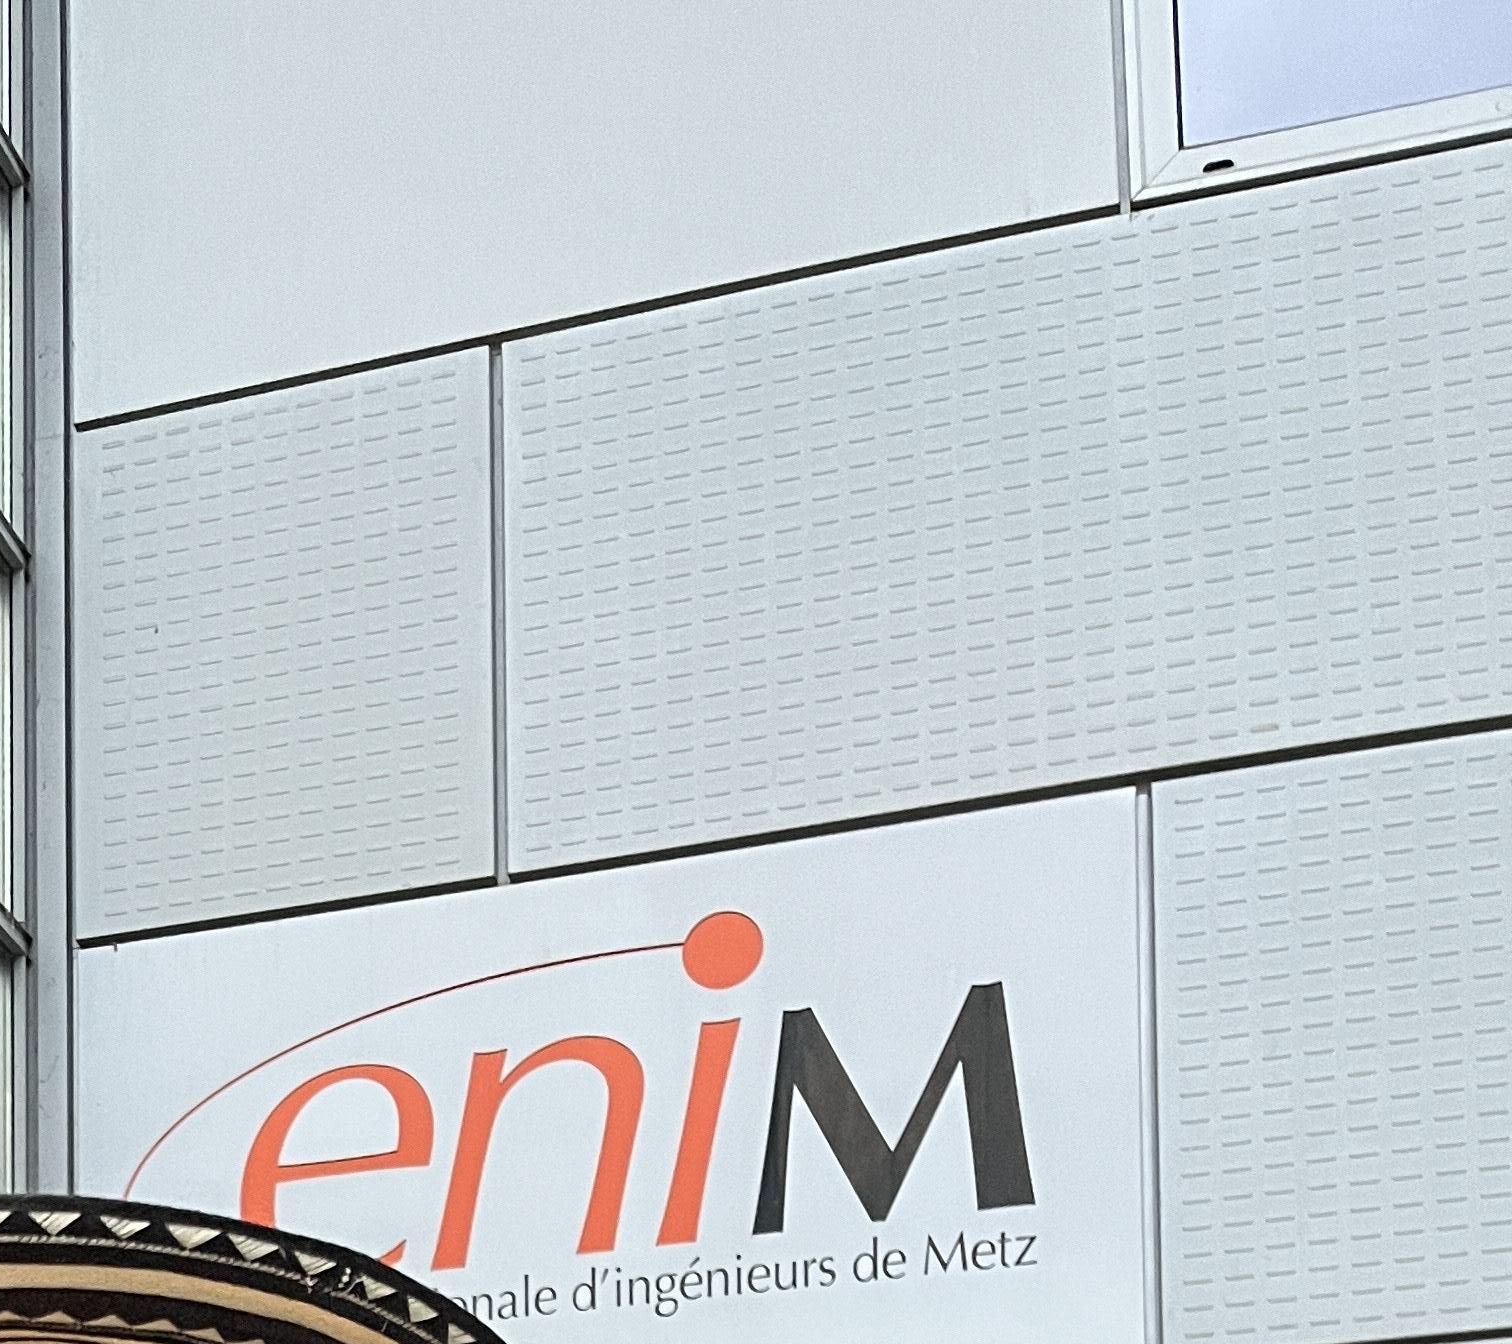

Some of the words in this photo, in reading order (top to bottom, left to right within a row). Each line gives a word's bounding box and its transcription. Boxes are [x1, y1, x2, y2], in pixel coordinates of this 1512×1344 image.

[571, 1253, 838, 1318] d'ingénieurs
[852, 1236, 907, 1284] de
[923, 1230, 1039, 1276] Metz
